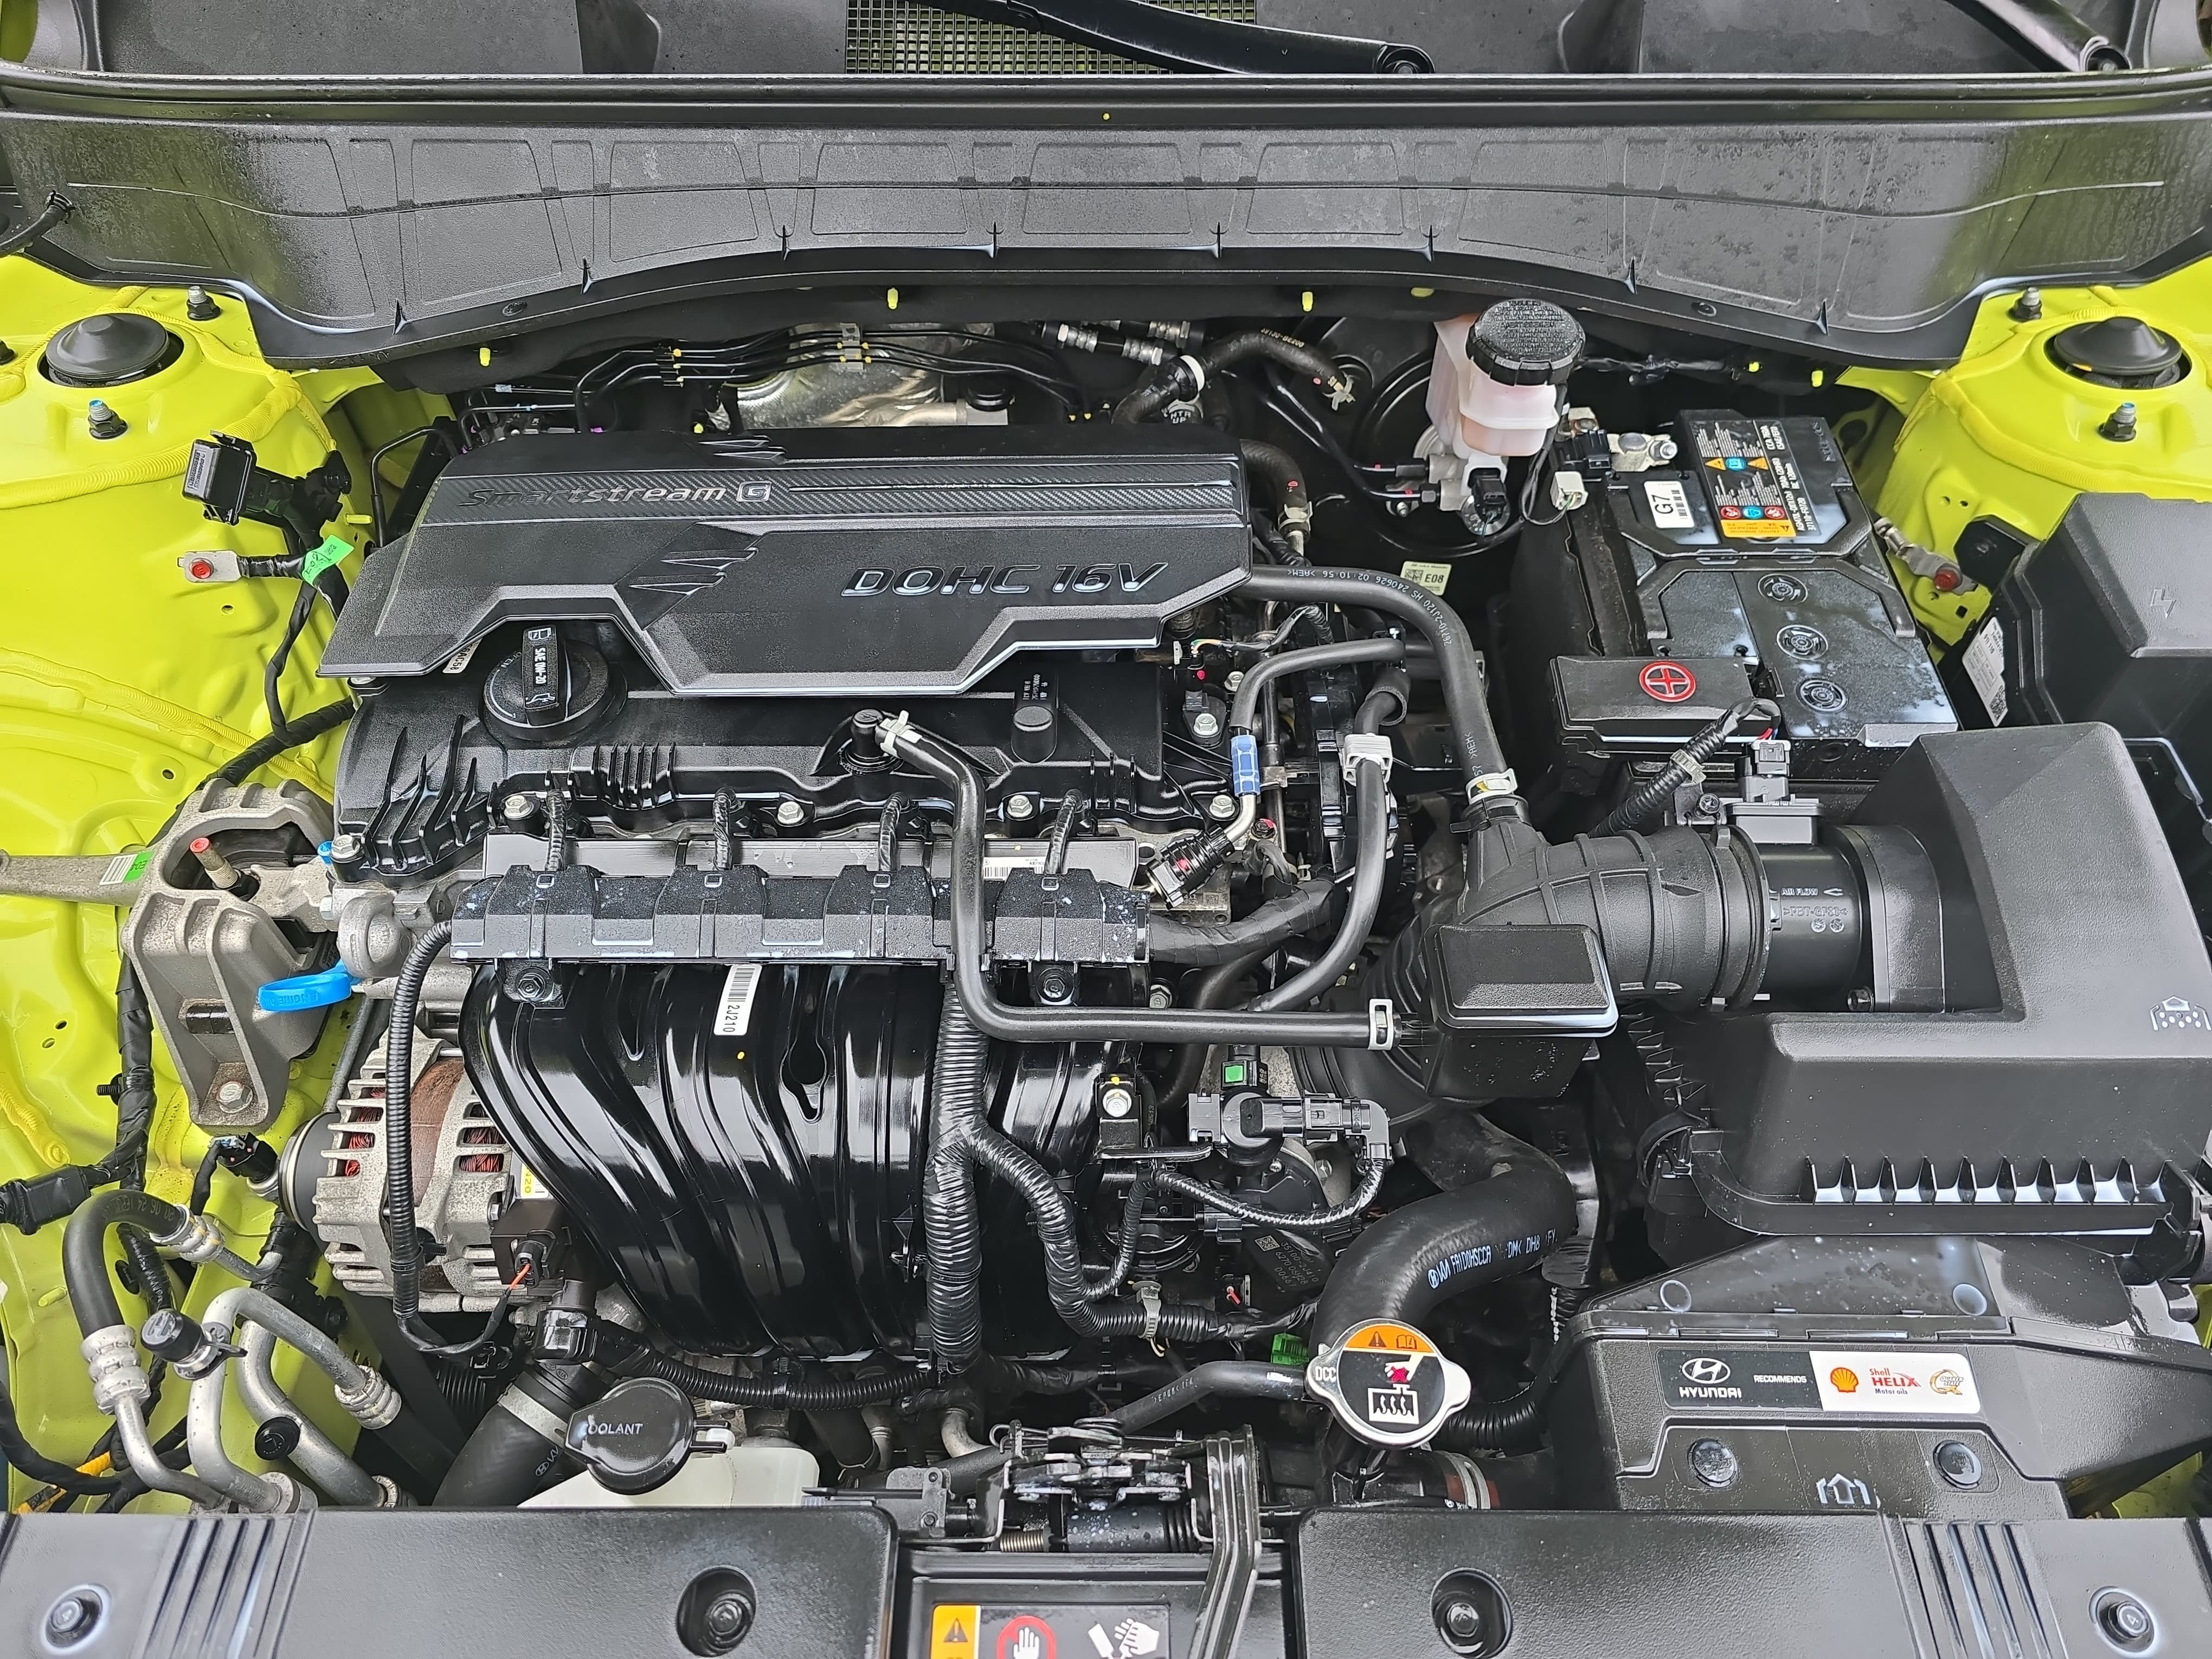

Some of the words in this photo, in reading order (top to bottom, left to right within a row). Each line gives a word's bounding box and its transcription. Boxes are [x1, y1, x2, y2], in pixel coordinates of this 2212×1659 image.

[1170, 411, 1191, 420] HTR
[459, 486, 728, 507] Smartstream
[1651, 494, 1674, 515] G7
[841, 563, 1042, 596] DOHC
[1052, 562, 1169, 594] 16V
[1424, 573, 1445, 584] E08
[534, 647, 546, 661] SAE
[534, 662, 546, 684] 0W-20
[723, 1005, 741, 1033] 2J210
[1315, 1366, 1336, 1382] DCC
[1869, 1367, 1891, 1376] Shell
[1679, 1386, 1742, 1400] HYUNDAI
[1753, 1374, 1808, 1384] RECOMMENDS
[1871, 1376, 1921, 1387] HELIX
[587, 1423, 644, 1435] OOLANT
